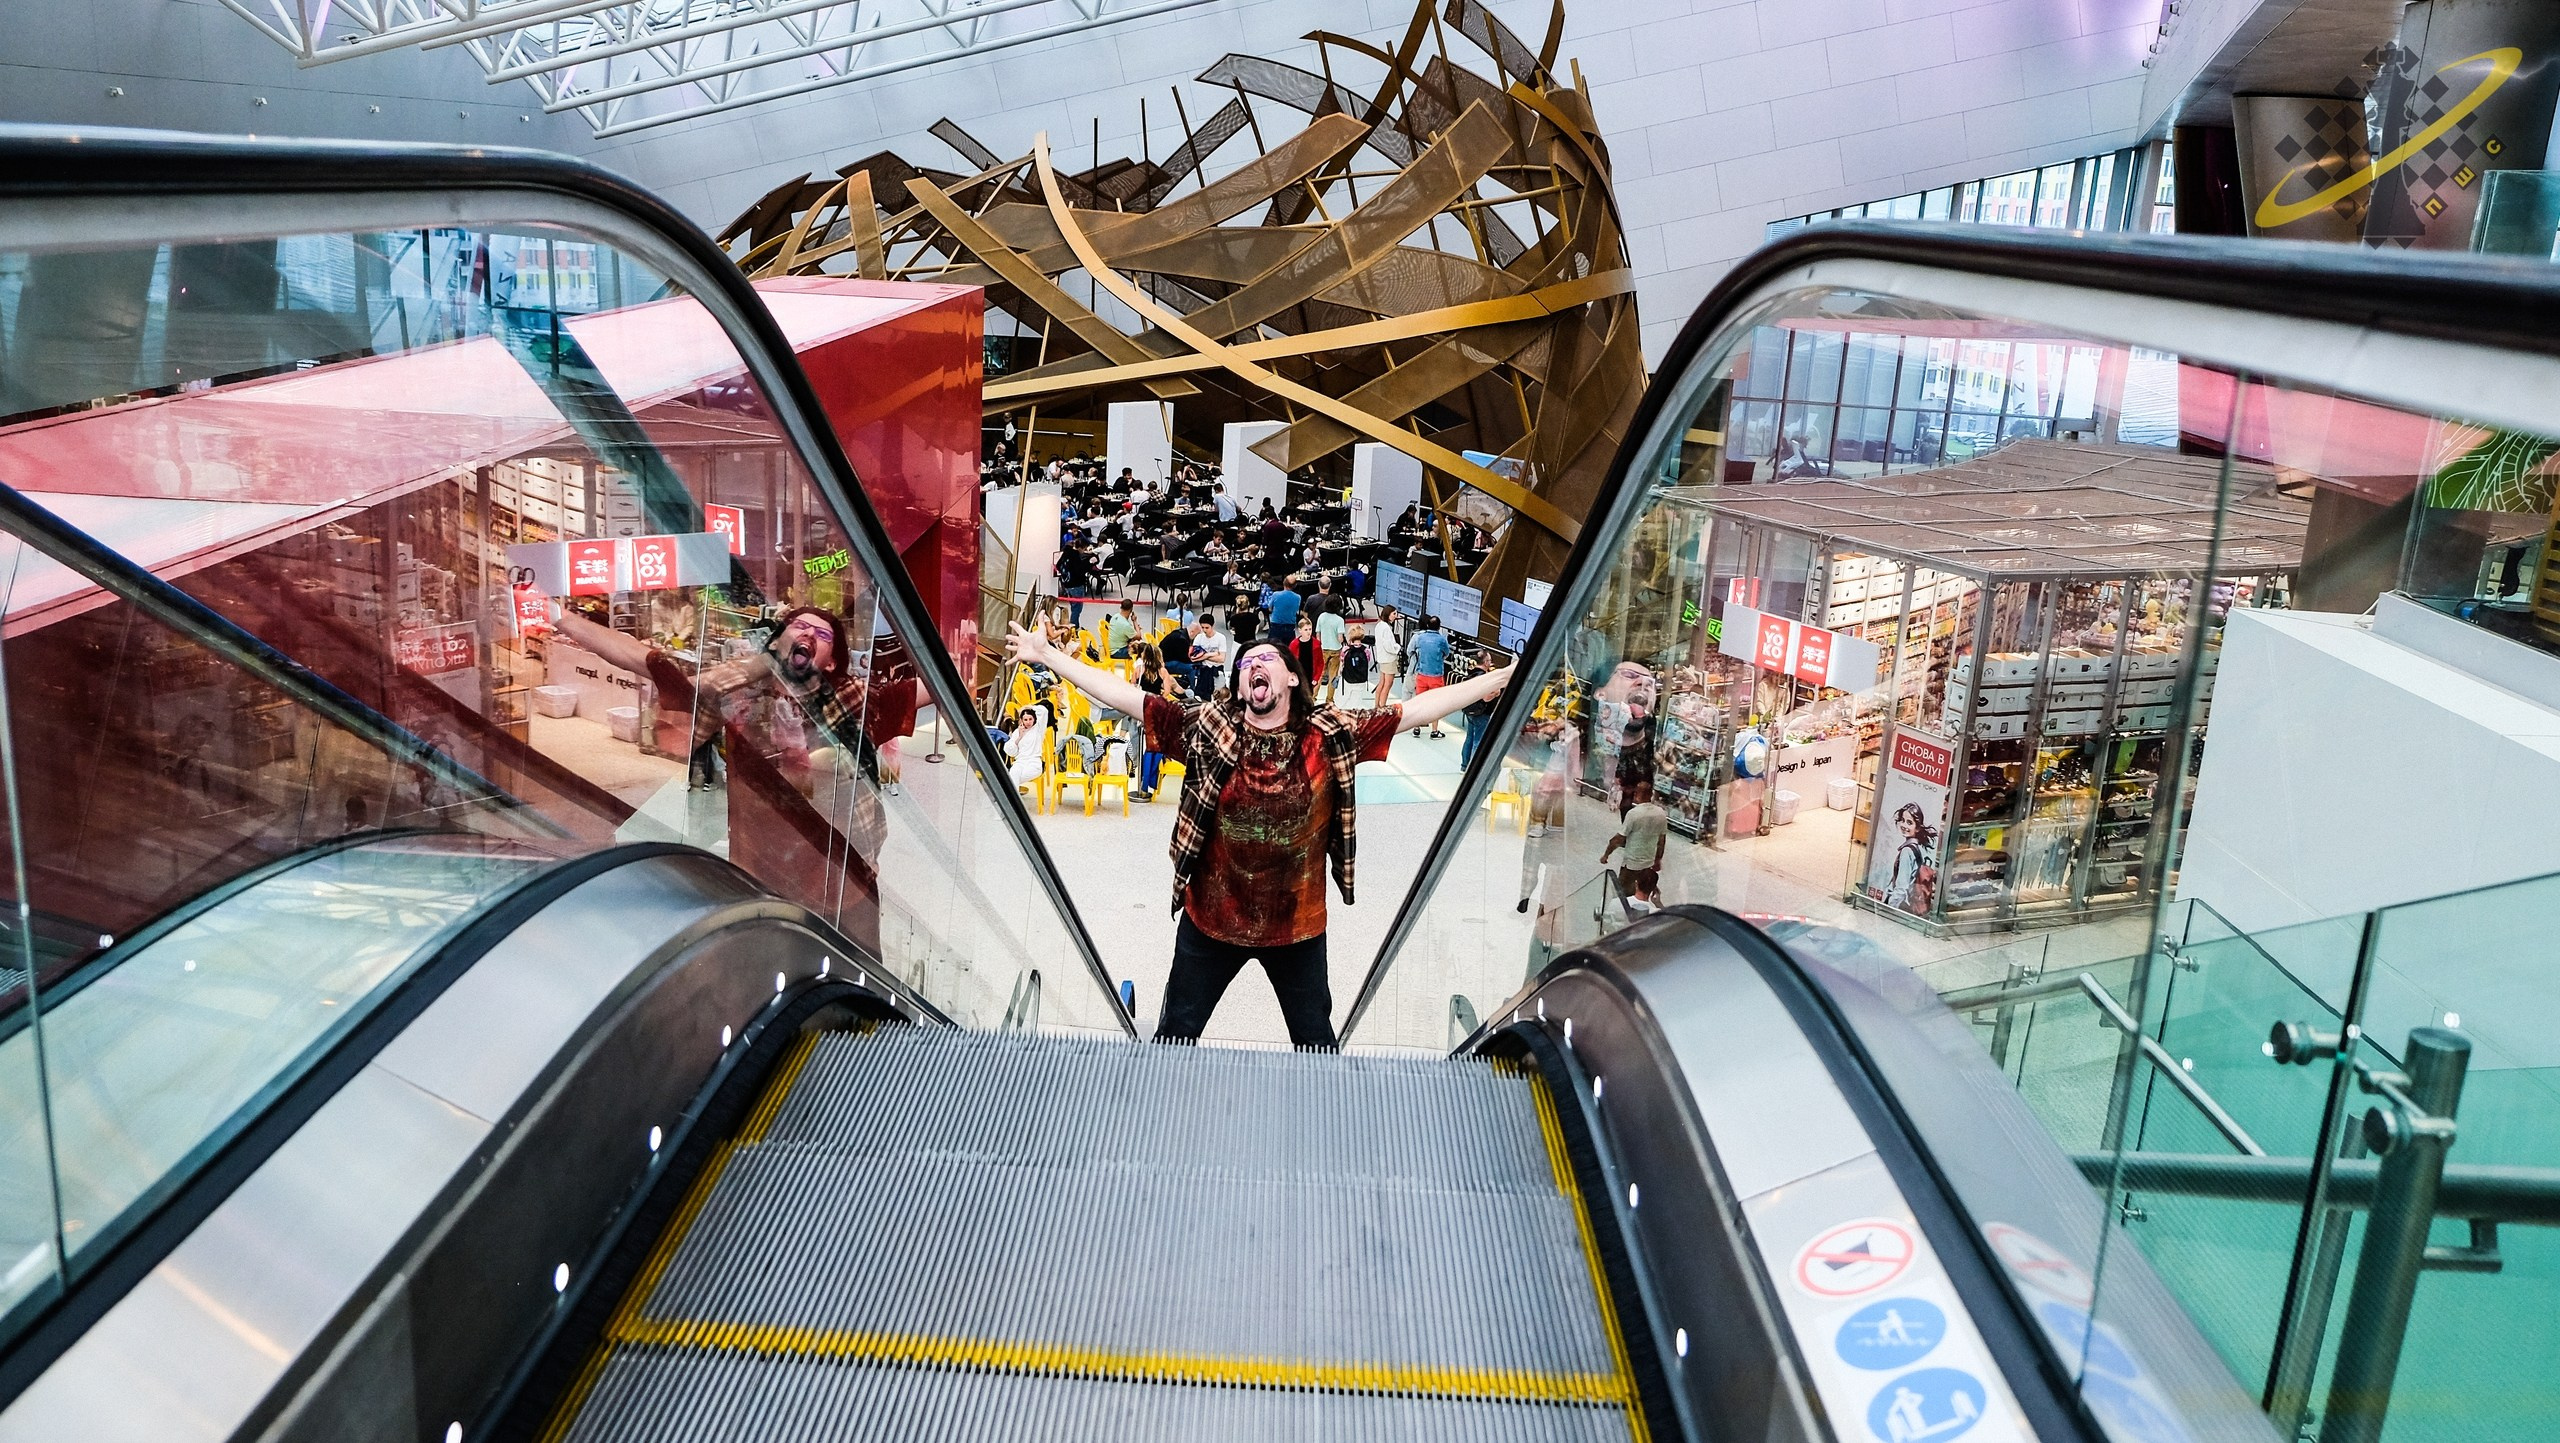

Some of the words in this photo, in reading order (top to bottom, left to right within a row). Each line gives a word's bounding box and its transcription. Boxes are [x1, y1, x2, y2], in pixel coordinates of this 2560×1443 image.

[1764, 630, 1784, 647] YO
[1762, 642, 1783, 659] KO
[1813, 756, 1832, 767] Japan
[1901, 741, 1935, 762] СНОВА
[1937, 753, 1945, 765] В
[1899, 755, 1942, 779] ШКОЛУ!
